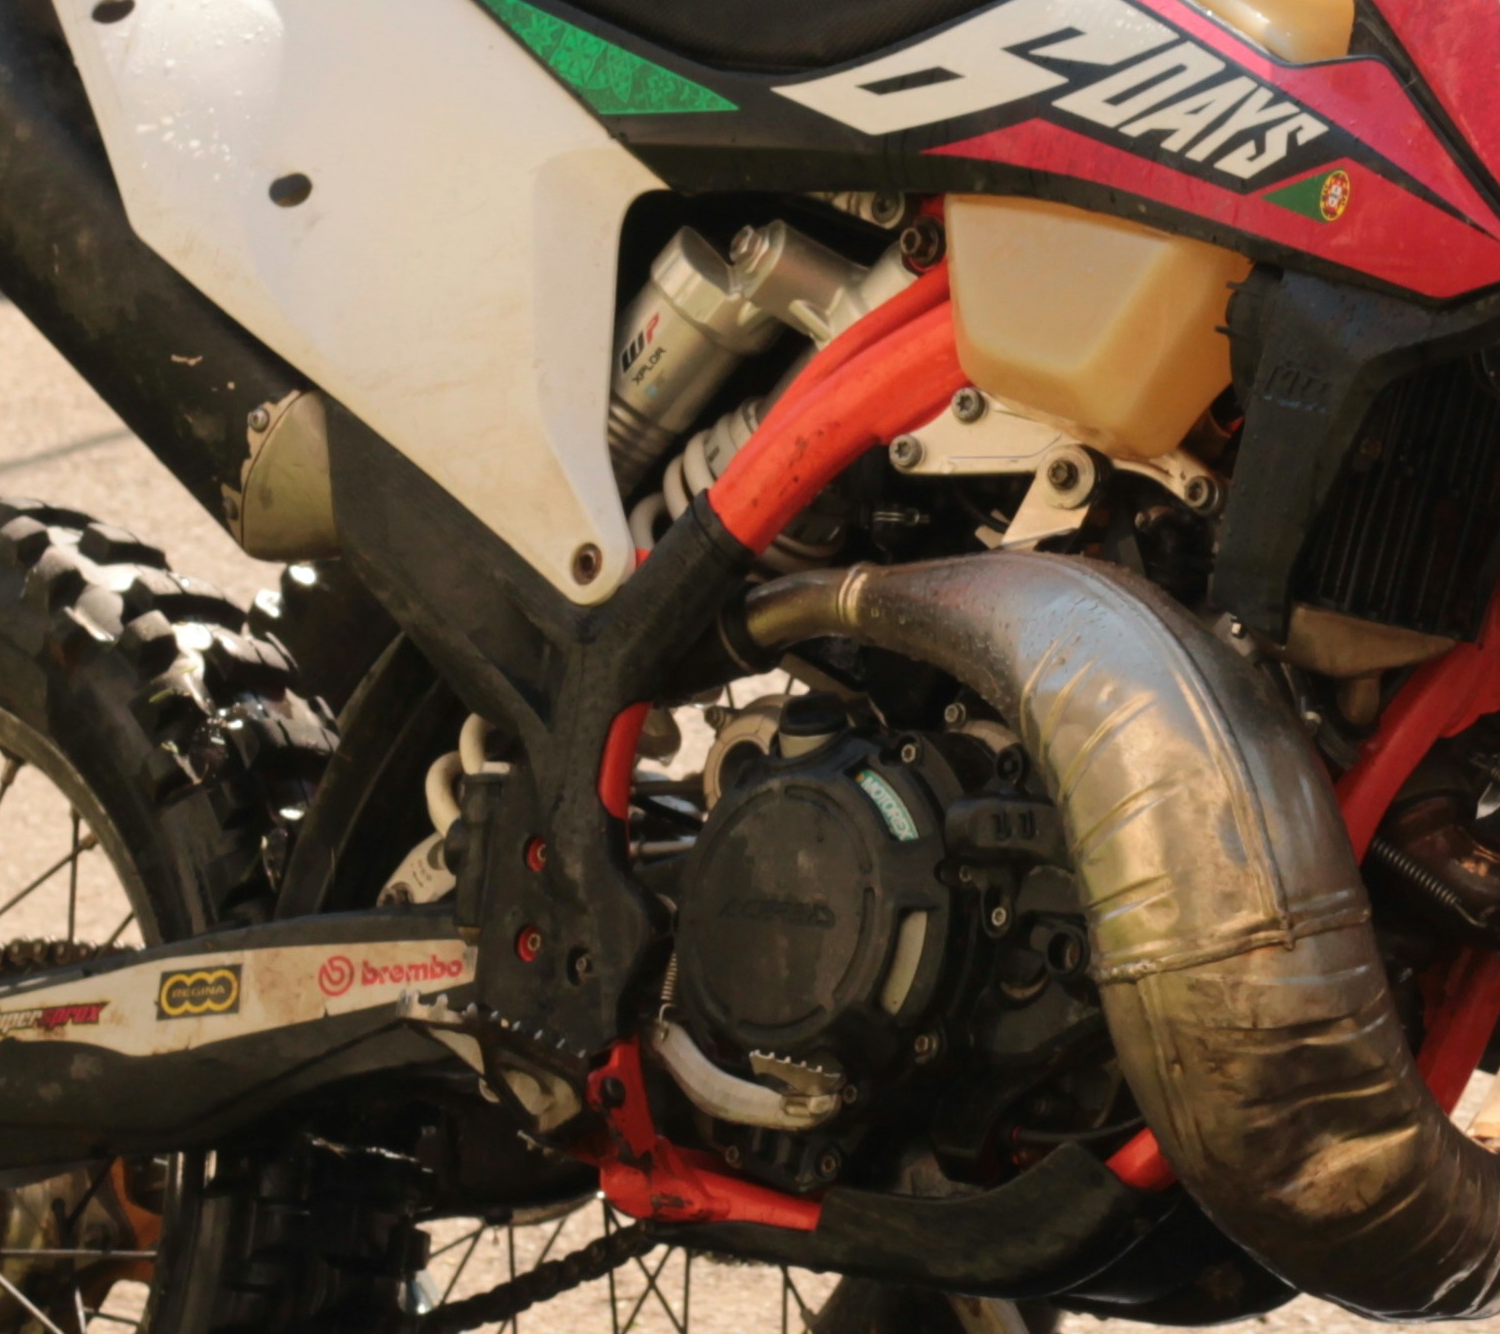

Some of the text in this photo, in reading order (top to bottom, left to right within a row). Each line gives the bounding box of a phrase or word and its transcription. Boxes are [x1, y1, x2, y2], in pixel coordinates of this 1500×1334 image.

[860, 776, 916, 842] MOTOREX
[361, 954, 464, 986] brembo
[171, 984, 226, 999] REGINA
